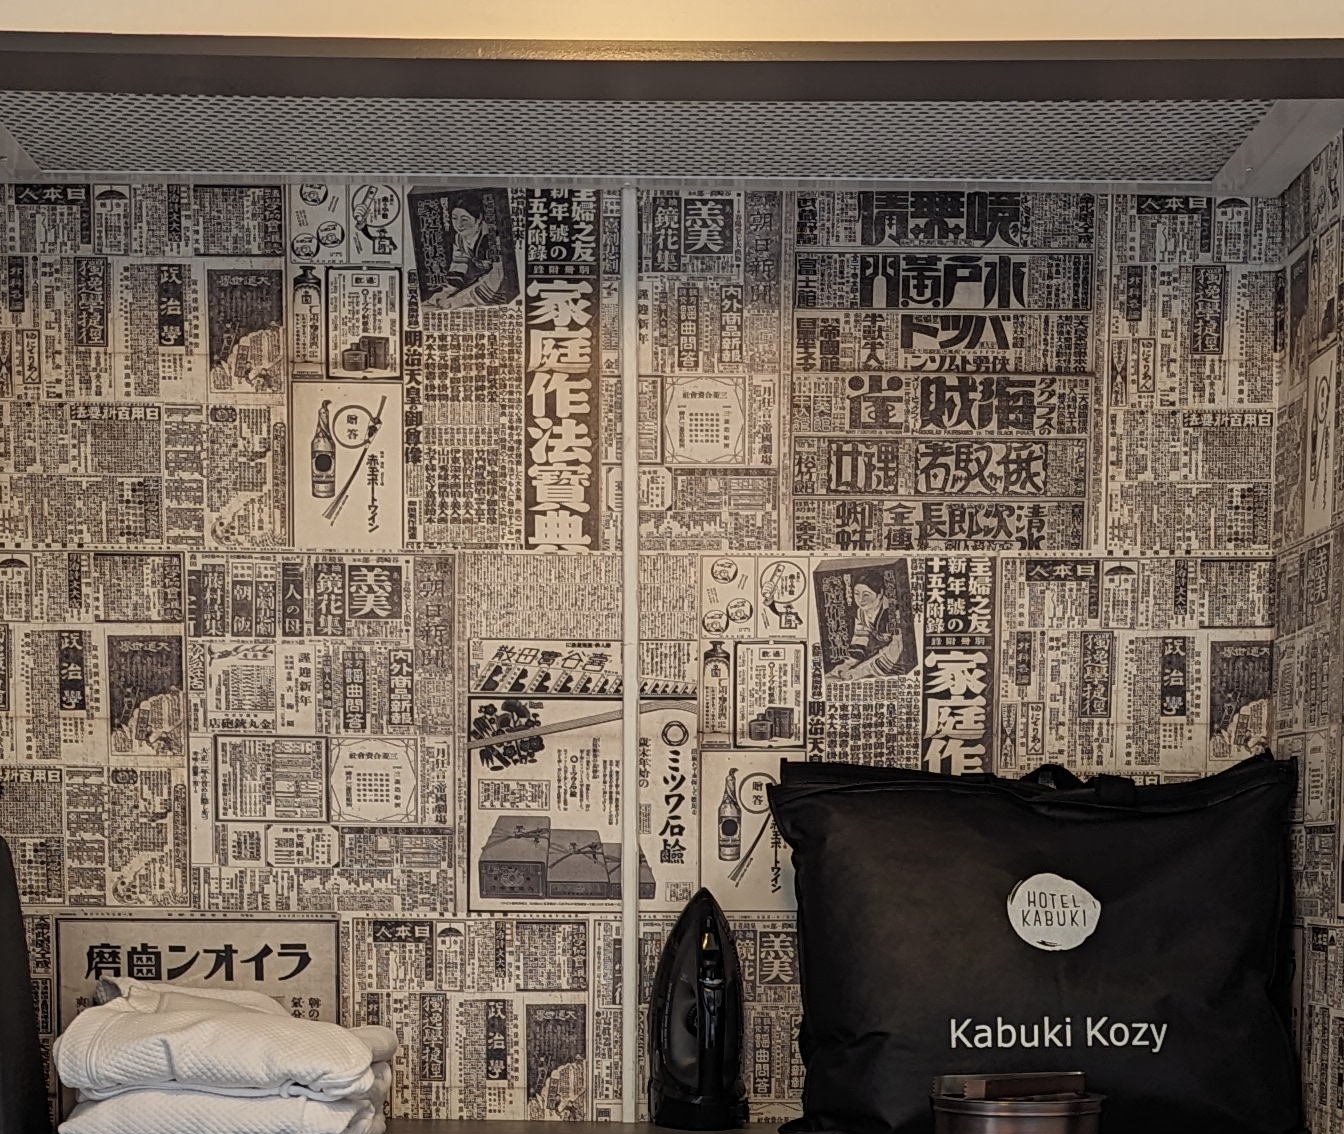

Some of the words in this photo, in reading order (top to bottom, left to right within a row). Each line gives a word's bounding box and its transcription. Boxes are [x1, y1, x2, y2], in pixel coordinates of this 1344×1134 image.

[17, 187, 86, 202] 日本人
[1140, 197, 1208, 210] 日本人
[655, 207, 679, 271] 鏡花集
[1028, 564, 1096, 577] 日本人
[284, 564, 302, 634] 三人の母
[316, 573, 343, 635] 鏡花集
[946, 557, 966, 632] 新年號の
[968, 557, 992, 634] 主婦之友
[1027, 890, 1081, 909] HOTEL
[375, 925, 431, 939] 日本人
[1021, 909, 1087, 928] KABUKI
[950, 1016, 1072, 1049] Kabuki
[1086, 1016, 1168, 1053] Kozy
